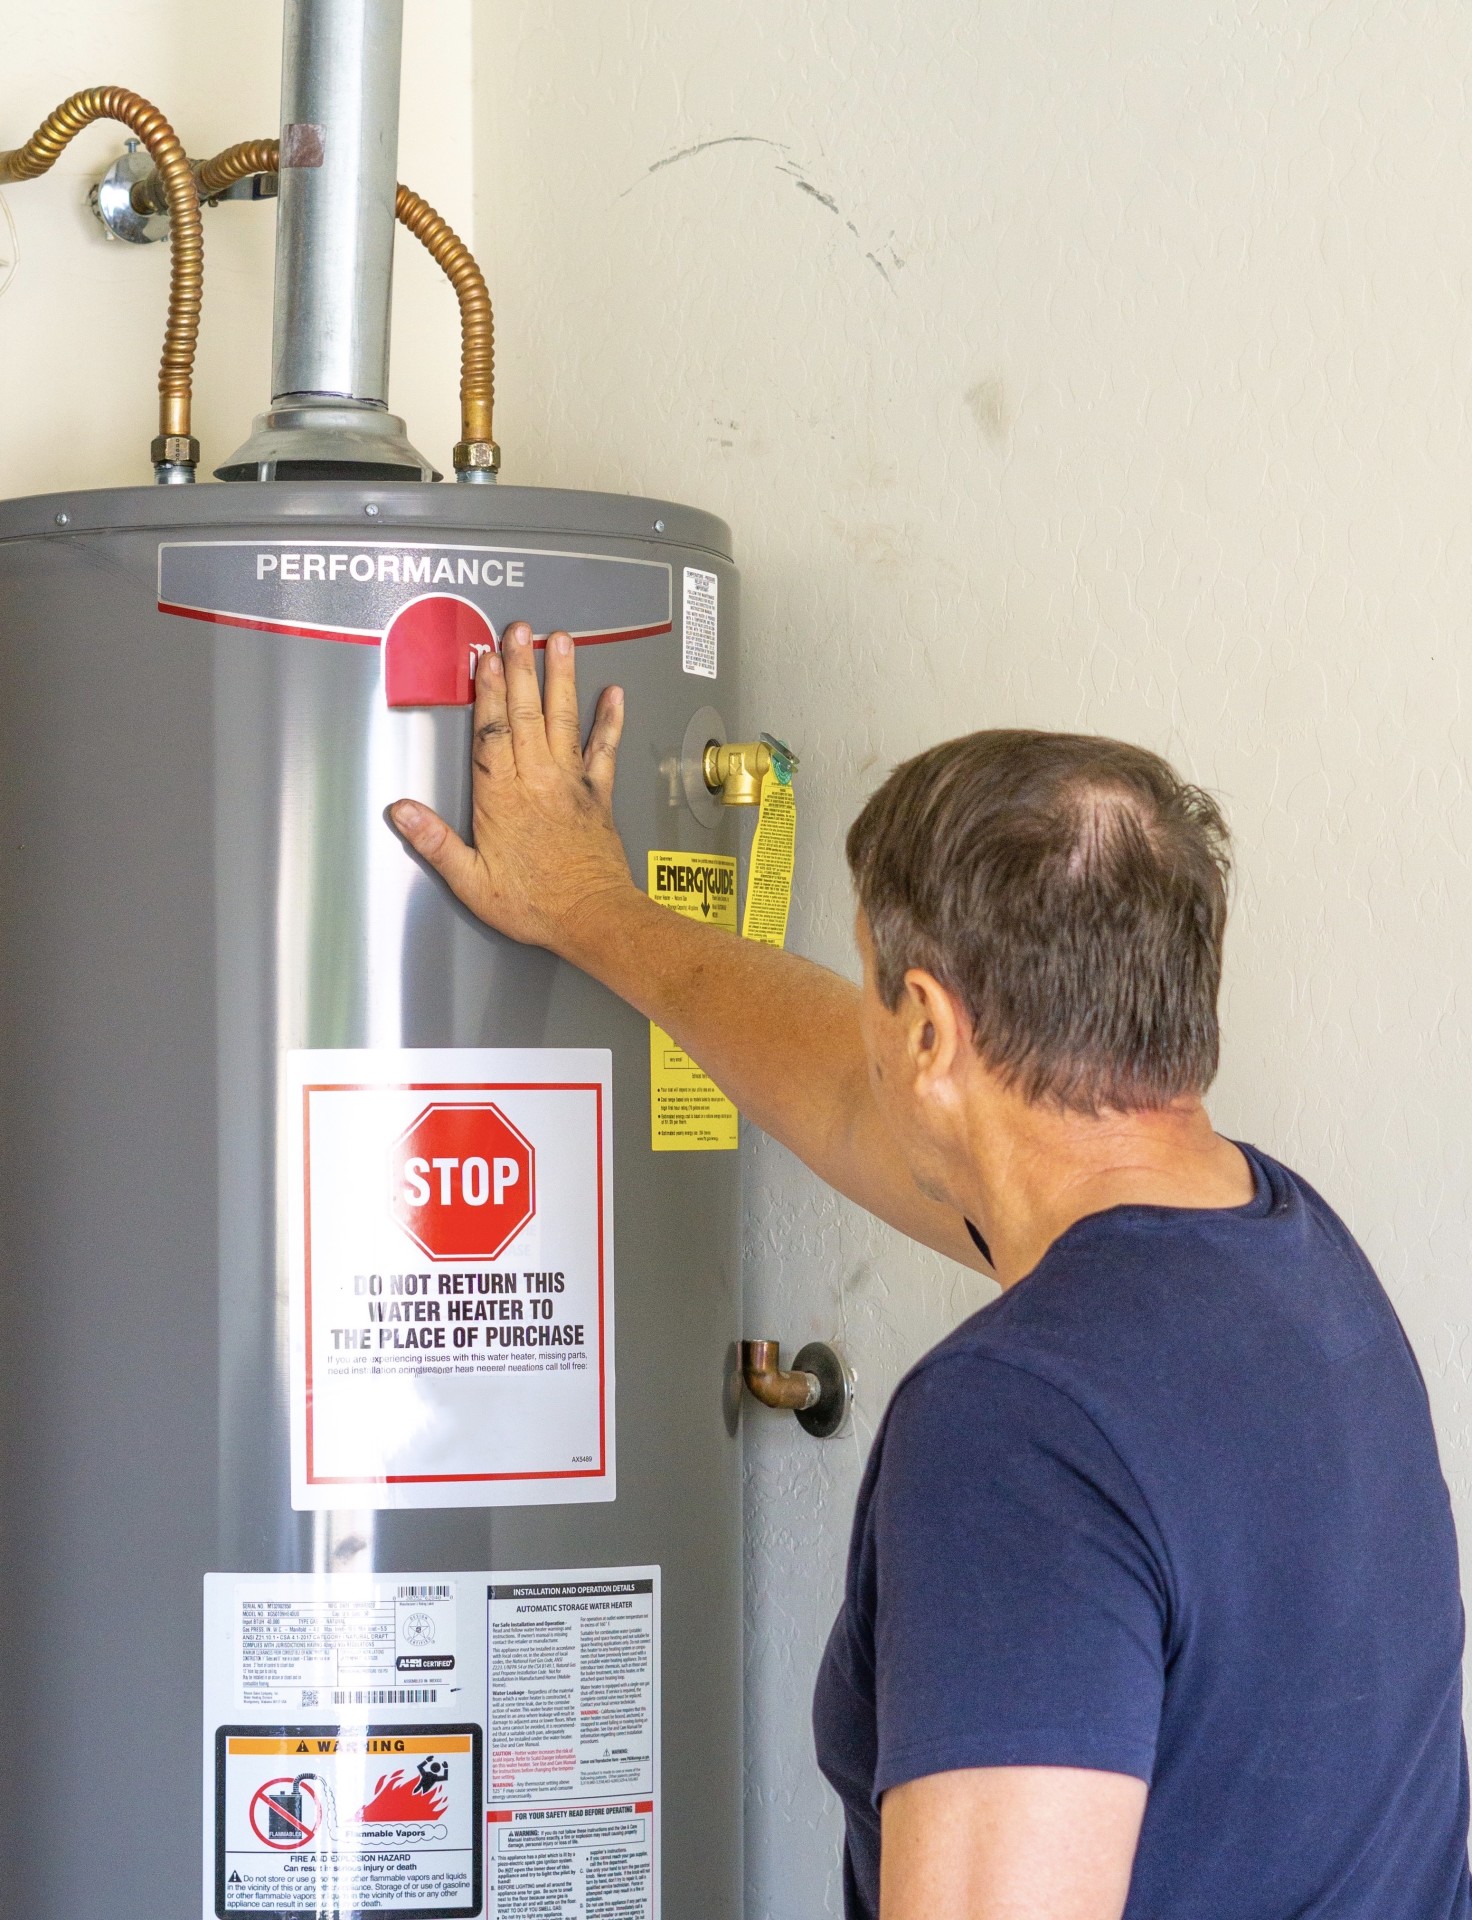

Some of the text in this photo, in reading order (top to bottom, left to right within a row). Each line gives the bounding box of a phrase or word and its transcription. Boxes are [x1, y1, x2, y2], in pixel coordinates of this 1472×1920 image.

[256, 554, 525, 588] PERFORMANCE
[656, 864, 734, 896] ENERGYGUIDE
[403, 1157, 520, 1206] STOP
[354, 1272, 565, 1296] DO NOT RETURN THIS
[368, 1298, 553, 1322] WATER HEATER TO
[330, 1325, 585, 1349] THE PLACE OF PURCHASE
[335, 1357, 351, 1365] you
[424, 1353, 451, 1361] issues
[487, 1352, 509, 1360] water
[511, 1351, 537, 1361] heater,
[538, 1351, 566, 1361] missing
[568, 1350, 588, 1360] parts,
[327, 1366, 349, 1374] need
[352, 1365, 396, 1374] instllation
[514, 1587, 560, 1596] INSTALLATION
[578, 1585, 612, 1594] OPERATION
[516, 1604, 557, 1612] AUTOMATIC
[558, 1603, 588, 1611] STORAGE
[606, 1807, 632, 1815] OPERATING
[346, 1829, 425, 1839] Flammable Vapors
[363, 1864, 384, 1872] injury
[446, 1872, 467, 1881] liquids
[247, 1883, 269, 1892] vicinity
[375, 1882, 402, 1890] Storage
[443, 1881, 470, 1890] gasoline
[371, 1890, 394, 1899] vicinity
[228, 1900, 260, 1908] appliance
